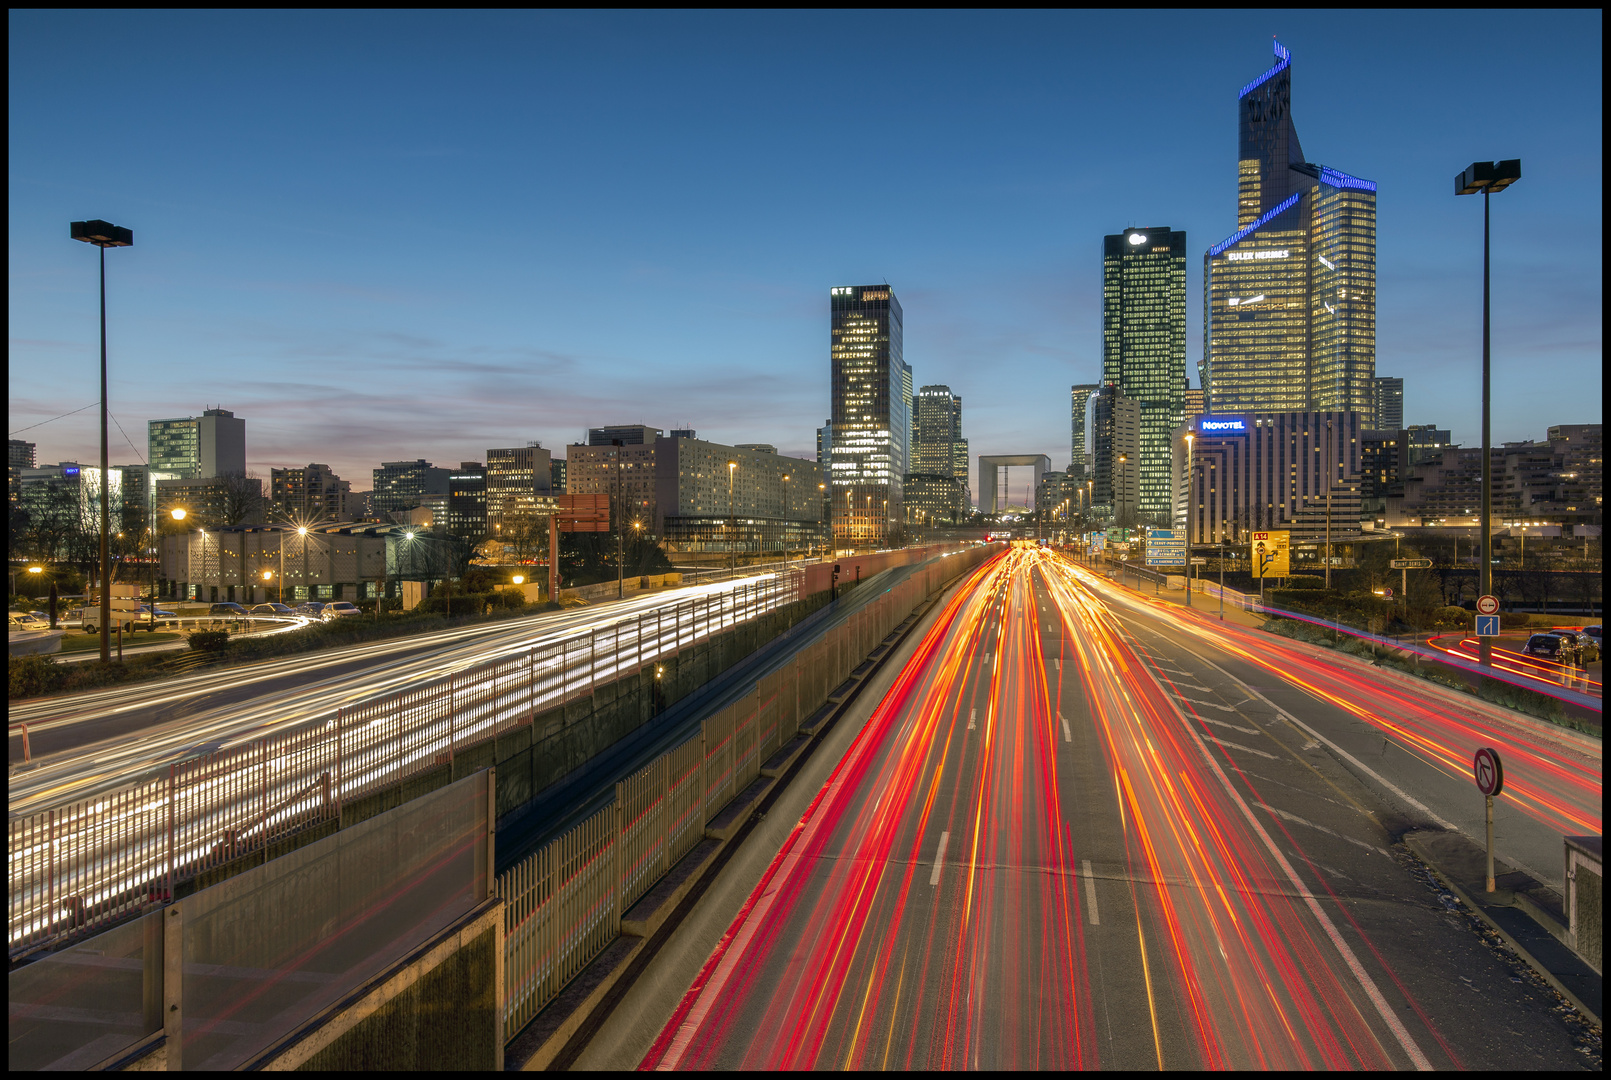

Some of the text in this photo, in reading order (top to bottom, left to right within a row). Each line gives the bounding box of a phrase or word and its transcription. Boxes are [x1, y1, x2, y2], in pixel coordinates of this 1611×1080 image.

[1228, 249, 1289, 261] EULER HERMES
[831, 287, 852, 296] RTE
[1202, 421, 1245, 430] NOVOTEL
